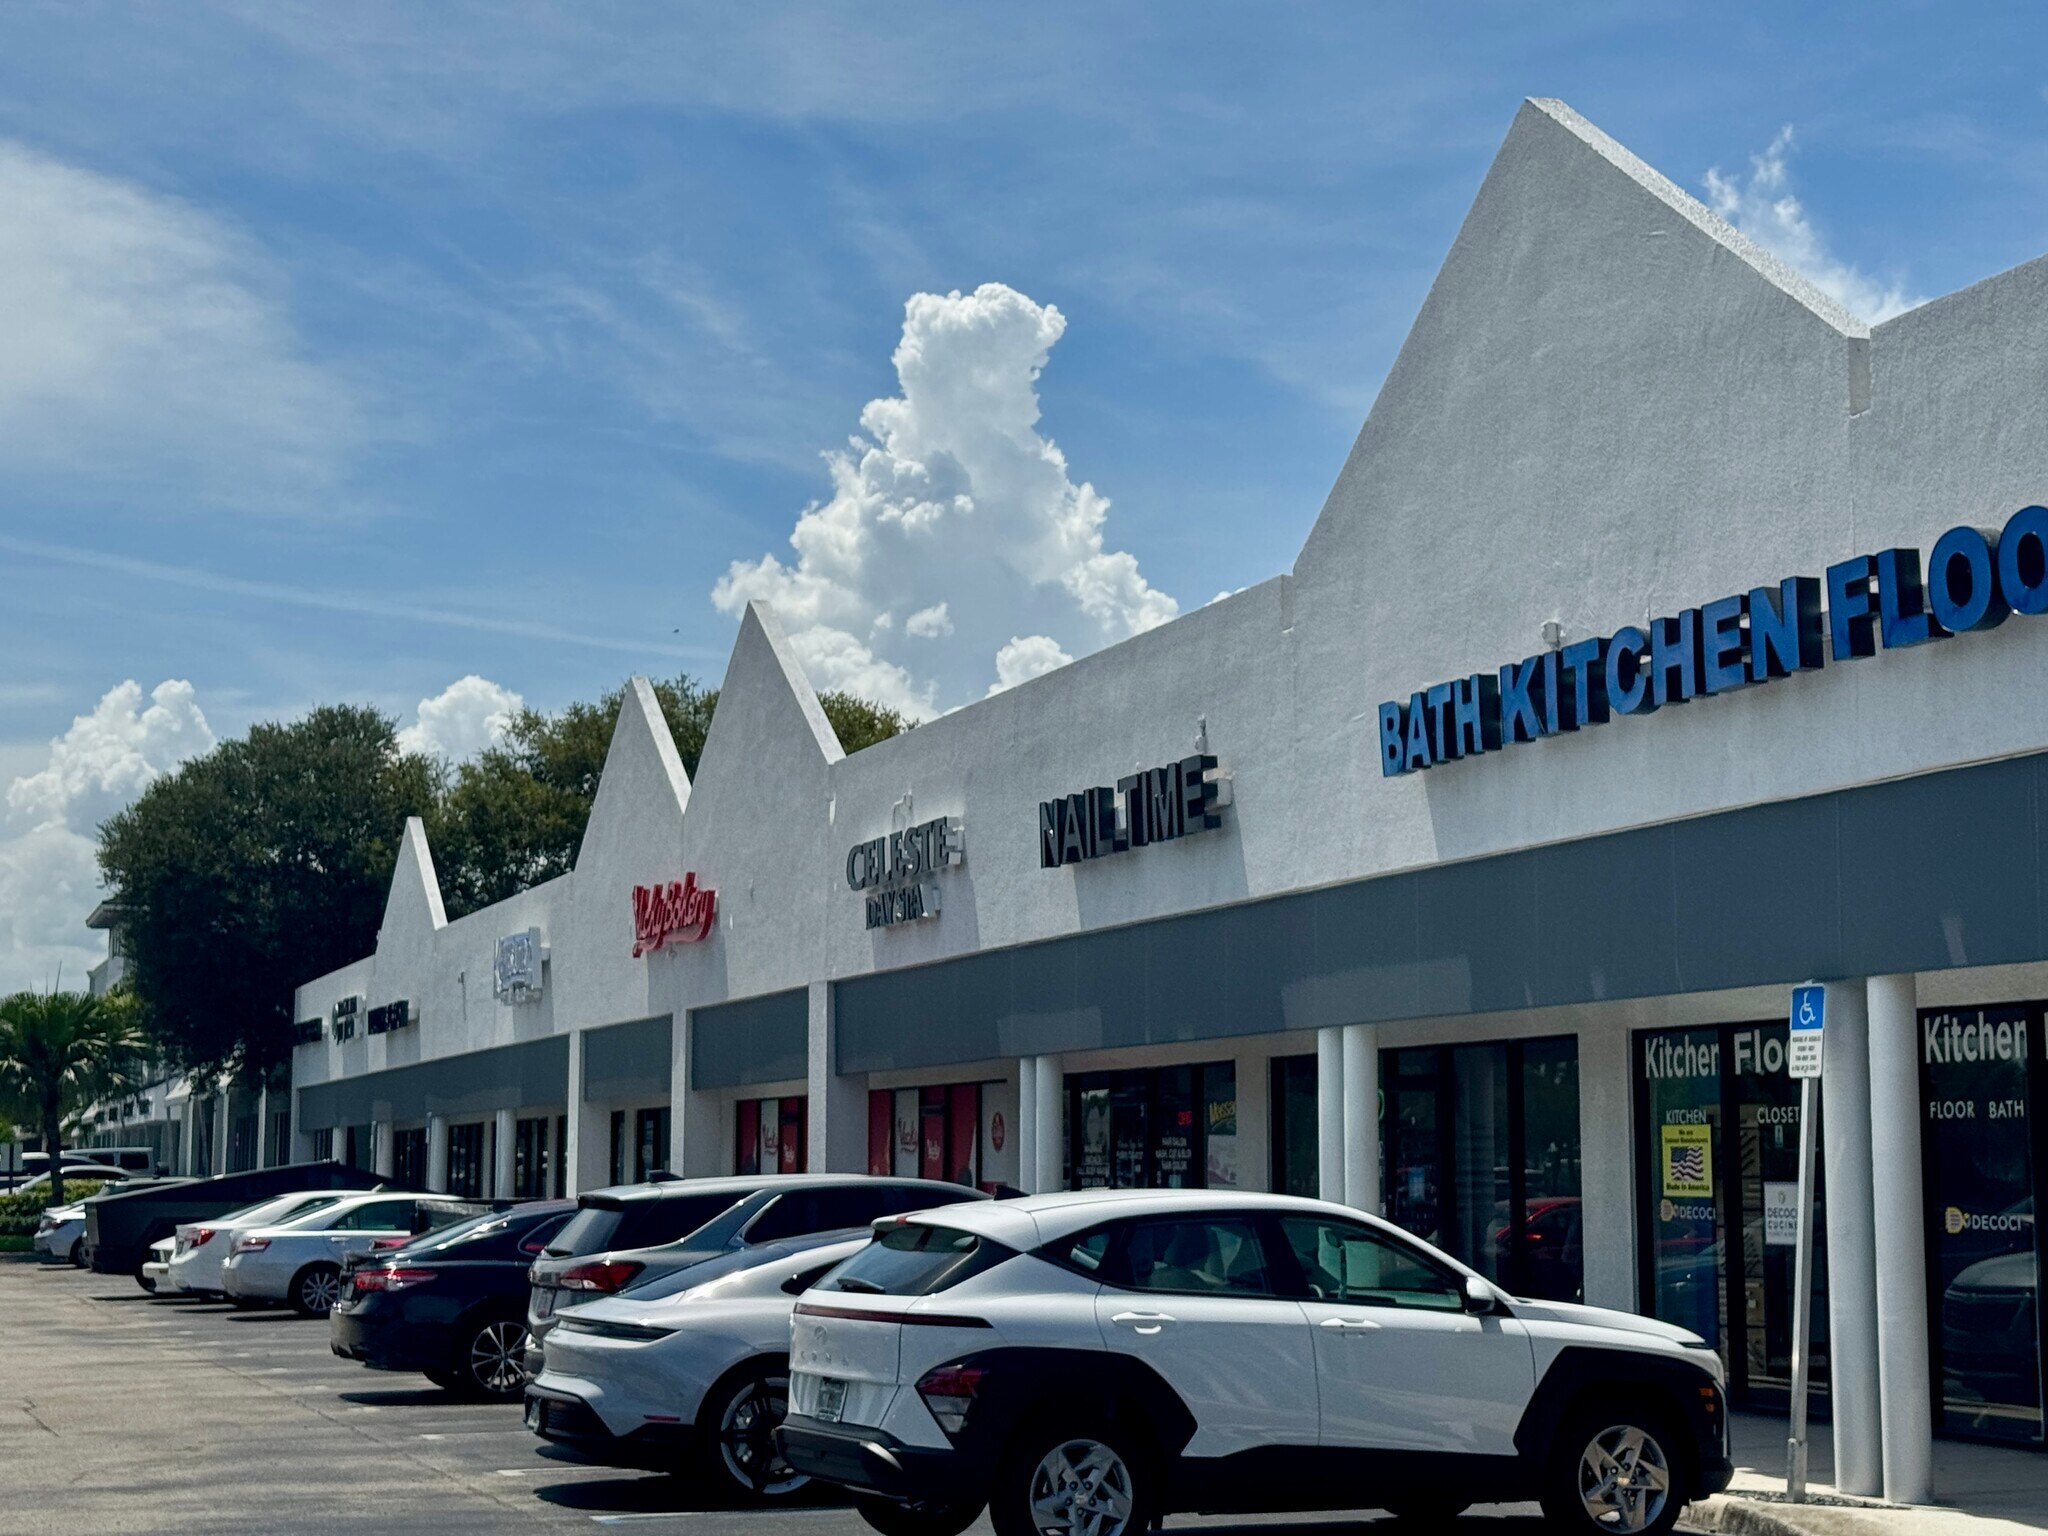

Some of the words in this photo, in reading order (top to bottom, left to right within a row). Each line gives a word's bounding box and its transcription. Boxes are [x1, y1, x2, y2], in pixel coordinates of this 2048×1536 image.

[1379, 674, 1501, 777] BATH
[1500, 575, 1824, 744] KITCHEN
[1040, 786, 1129, 868] NAIL
[1117, 755, 1221, 847] TIME
[846, 816, 952, 891] CELESTE
[865, 888, 895, 930] DAY
[895, 883, 926, 922] SPA
[1924, 1011, 2028, 1064] Kitchen
[1665, 1109, 1707, 1124] KITCHEN
[1757, 1106, 1800, 1124] CLOSET
[1929, 1100, 1976, 1119] FLOOR
[1988, 1100, 2025, 1119] BATH
[1768, 1207, 1798, 1219] DECOC
[1972, 1214, 2022, 1231] DECOCI
